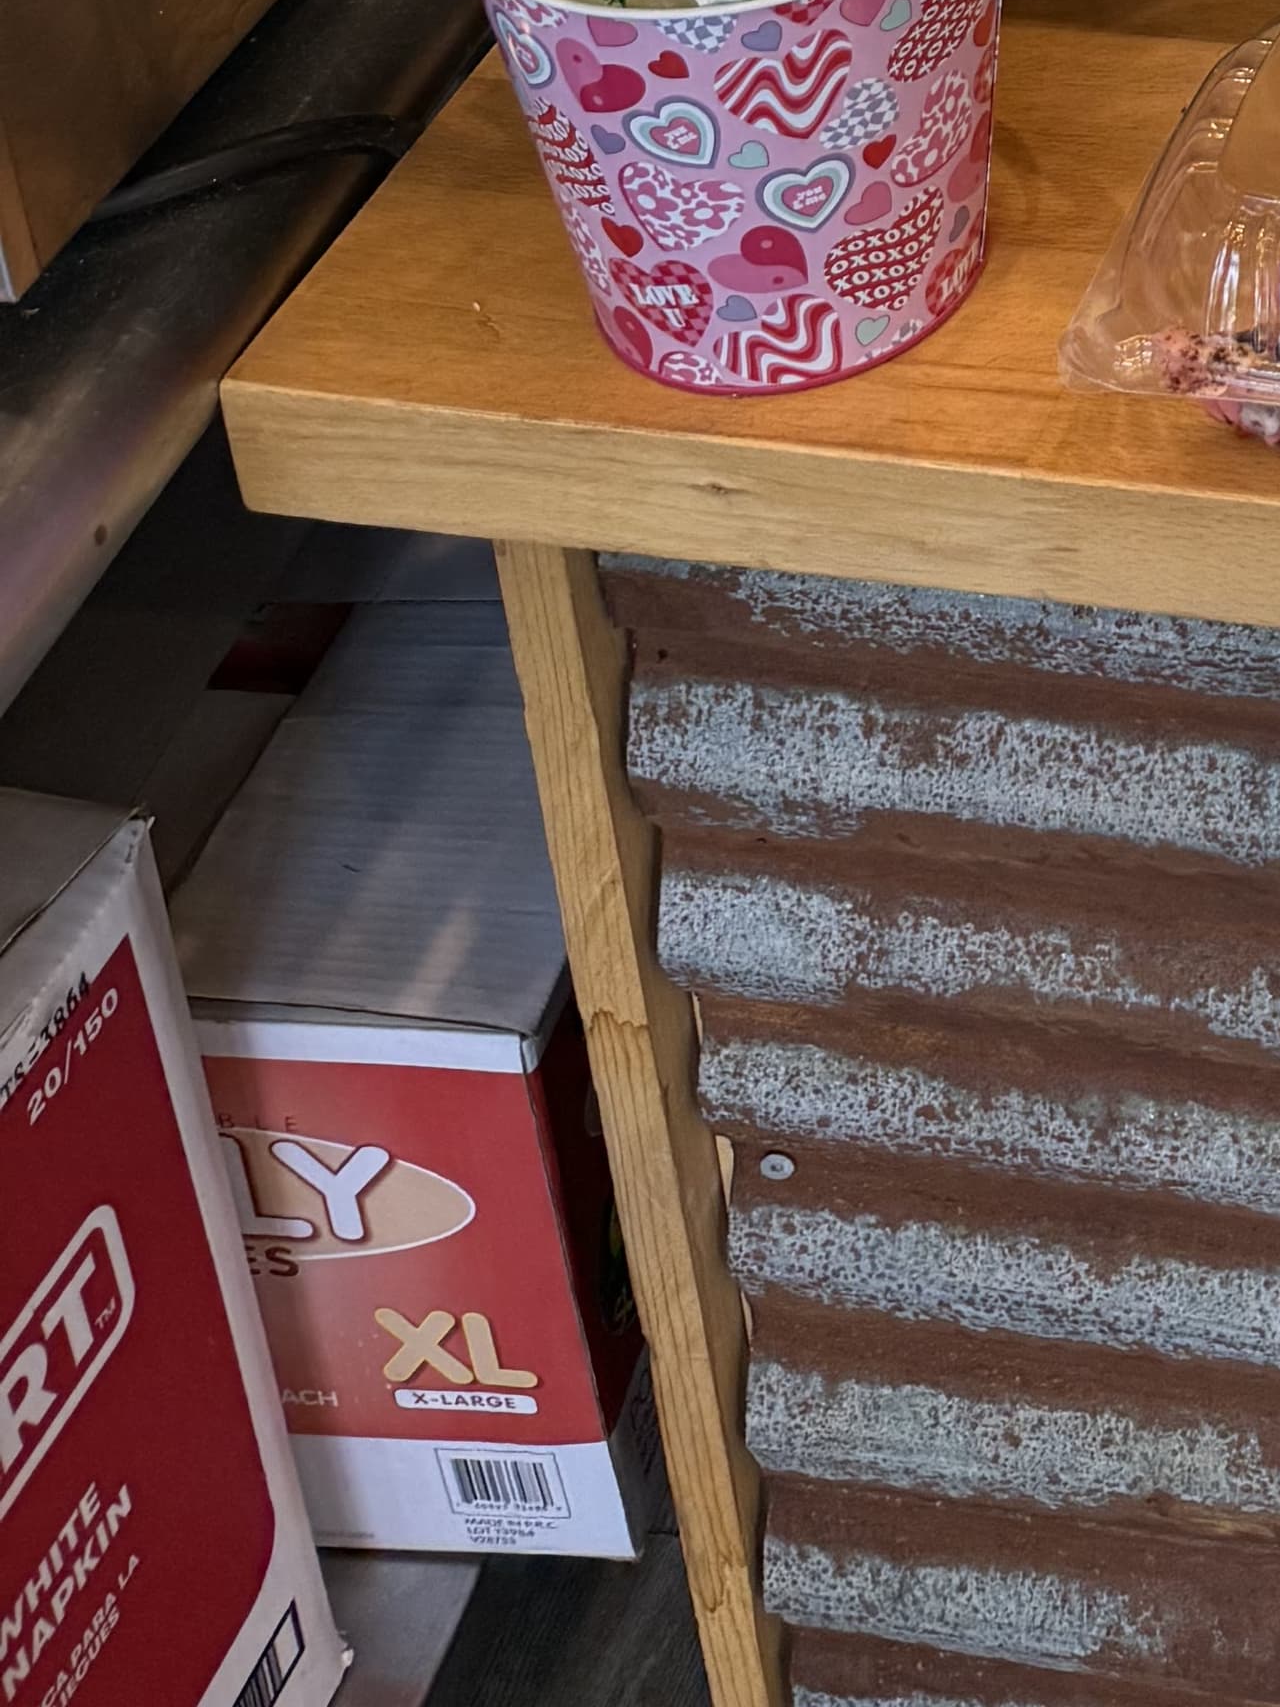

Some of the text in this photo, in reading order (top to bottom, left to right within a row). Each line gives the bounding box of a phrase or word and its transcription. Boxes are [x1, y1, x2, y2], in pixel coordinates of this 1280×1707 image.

[628, 283, 700, 307] LOVE
[662, 308, 686, 329] U
[27, 988, 118, 1126] 20/150
[374, 1307, 539, 1389] XL
[412, 1392, 517, 1409] X-LARGE
[0, 1482, 101, 1661] WHITE
[2, 1483, 132, 1703] NAPKIN
[70, 1592, 117, 1670] PARA
[118, 1554, 139, 1591] LA
